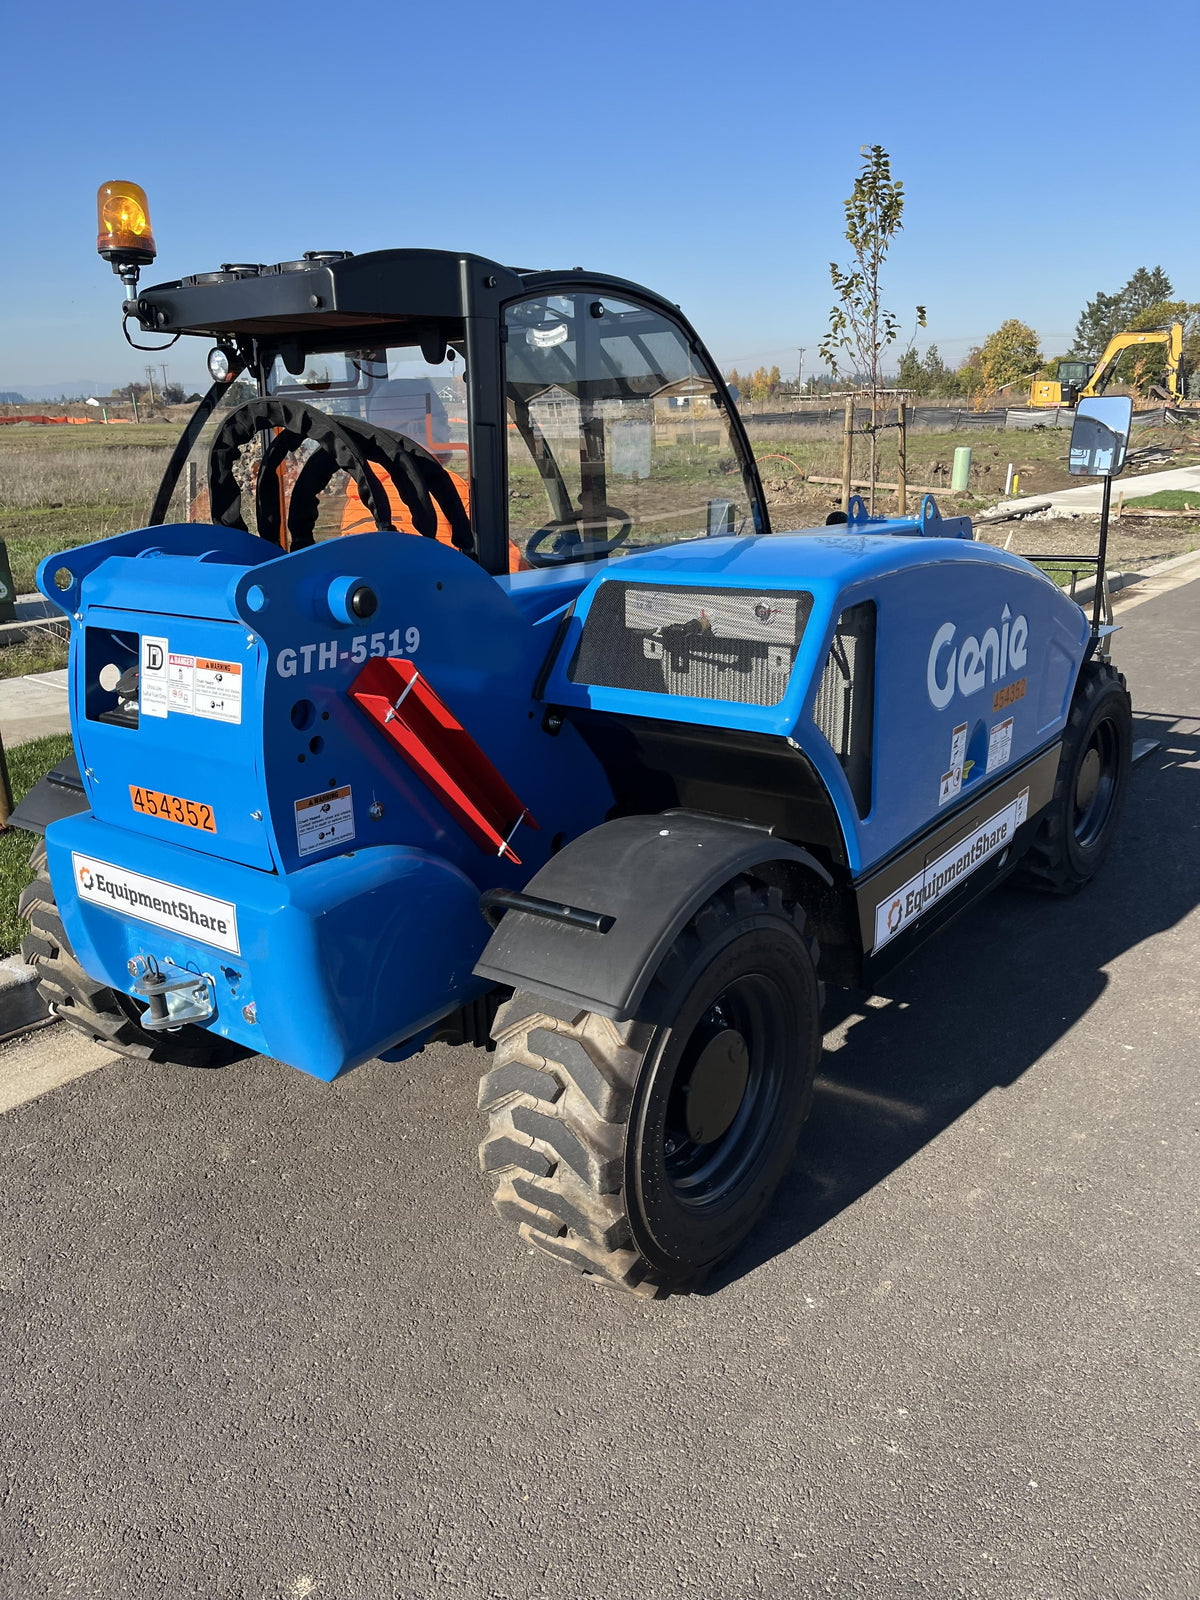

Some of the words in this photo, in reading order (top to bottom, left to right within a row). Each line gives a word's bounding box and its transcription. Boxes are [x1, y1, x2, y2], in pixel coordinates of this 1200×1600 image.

[210, 662, 231, 672] WARNING
[276, 626, 420, 678] GTH-5519
[927, 603, 1028, 709] Genie
[993, 678, 1026, 709] 454352
[134, 788, 214, 831] 454352
[314, 791, 339, 804] WARNING
[904, 822, 1007, 918] EquipmentShare
[95, 873, 227, 935] EquipmentShare
